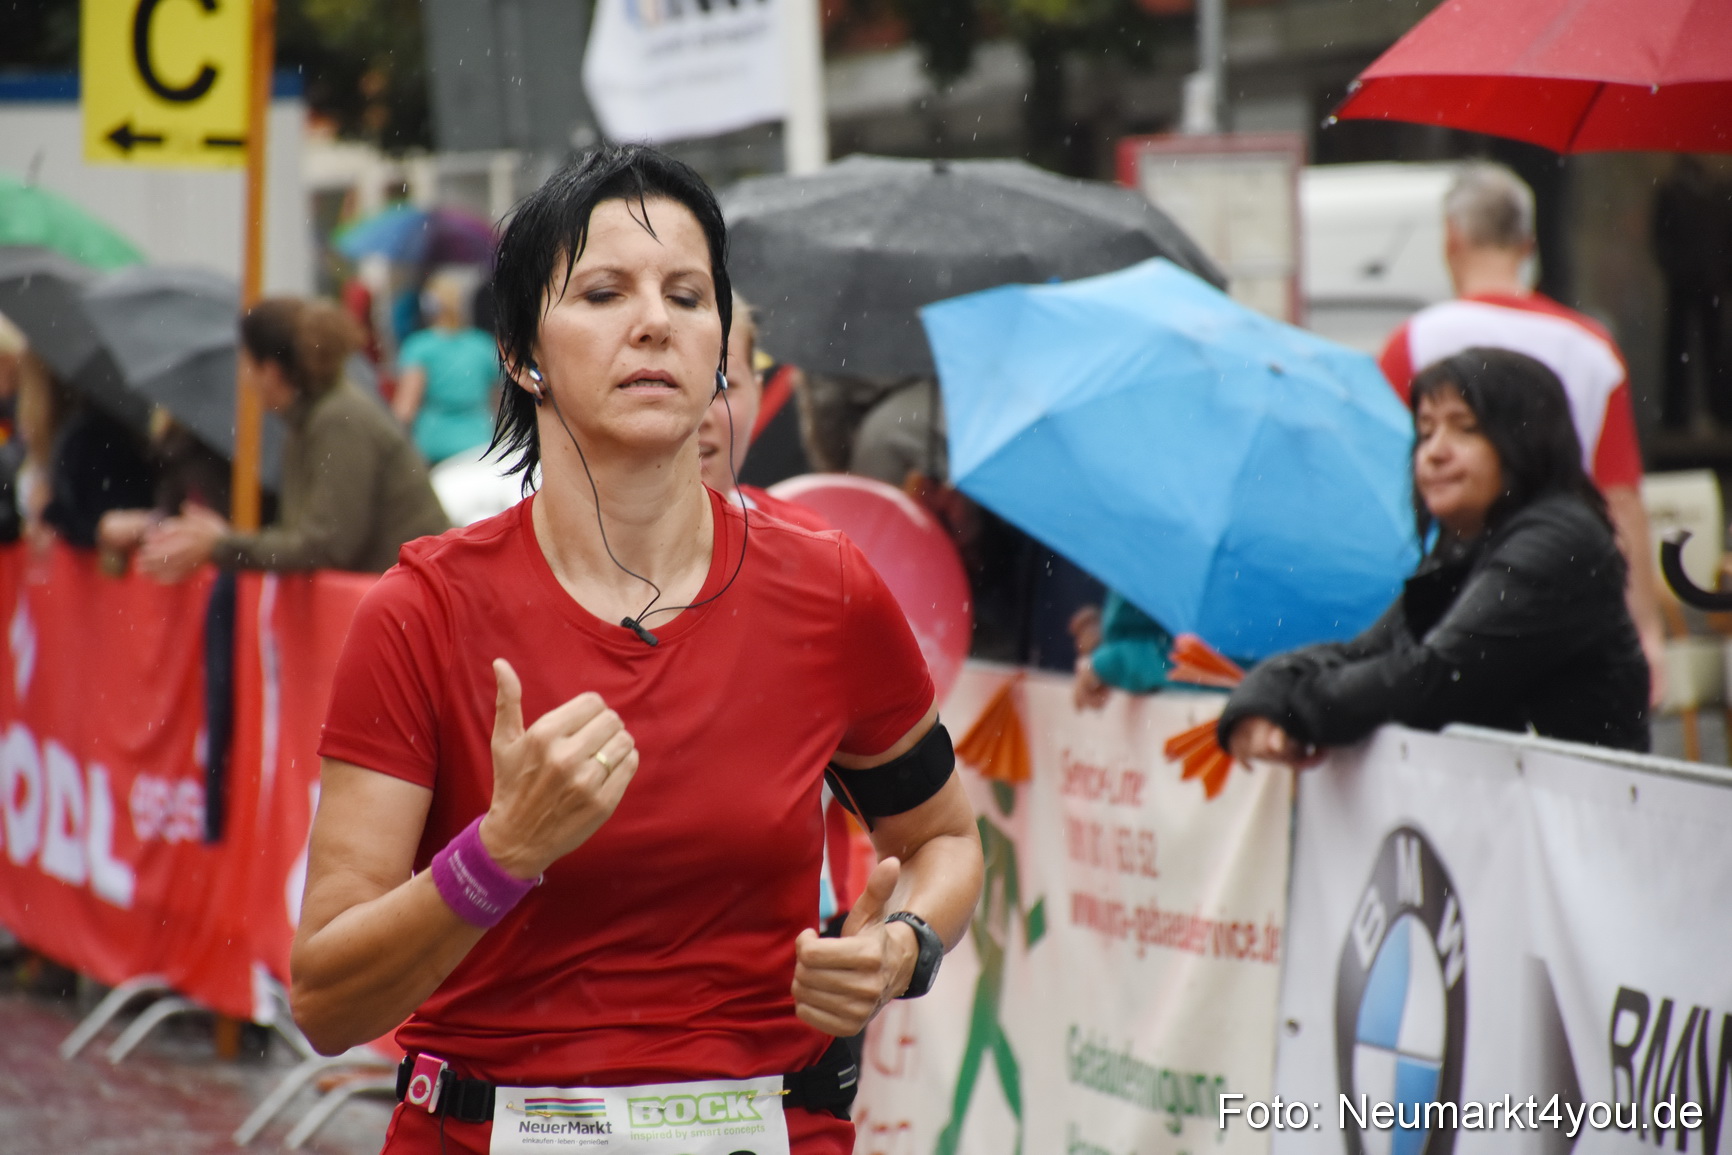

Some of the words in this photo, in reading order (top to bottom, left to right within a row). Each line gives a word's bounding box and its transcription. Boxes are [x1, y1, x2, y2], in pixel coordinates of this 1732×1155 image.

[133, 0, 217, 103] C
[0, 721, 135, 911] ODL
[1353, 833, 1465, 991] BMW
[518, 1120, 612, 1135] NeuerMarkt
[627, 1090, 763, 1128] BOCK
[630, 1130, 672, 1141] inspired
[675, 1128, 687, 1139] by
[691, 1127, 721, 1137] smart
[724, 1124, 766, 1136] concepts
